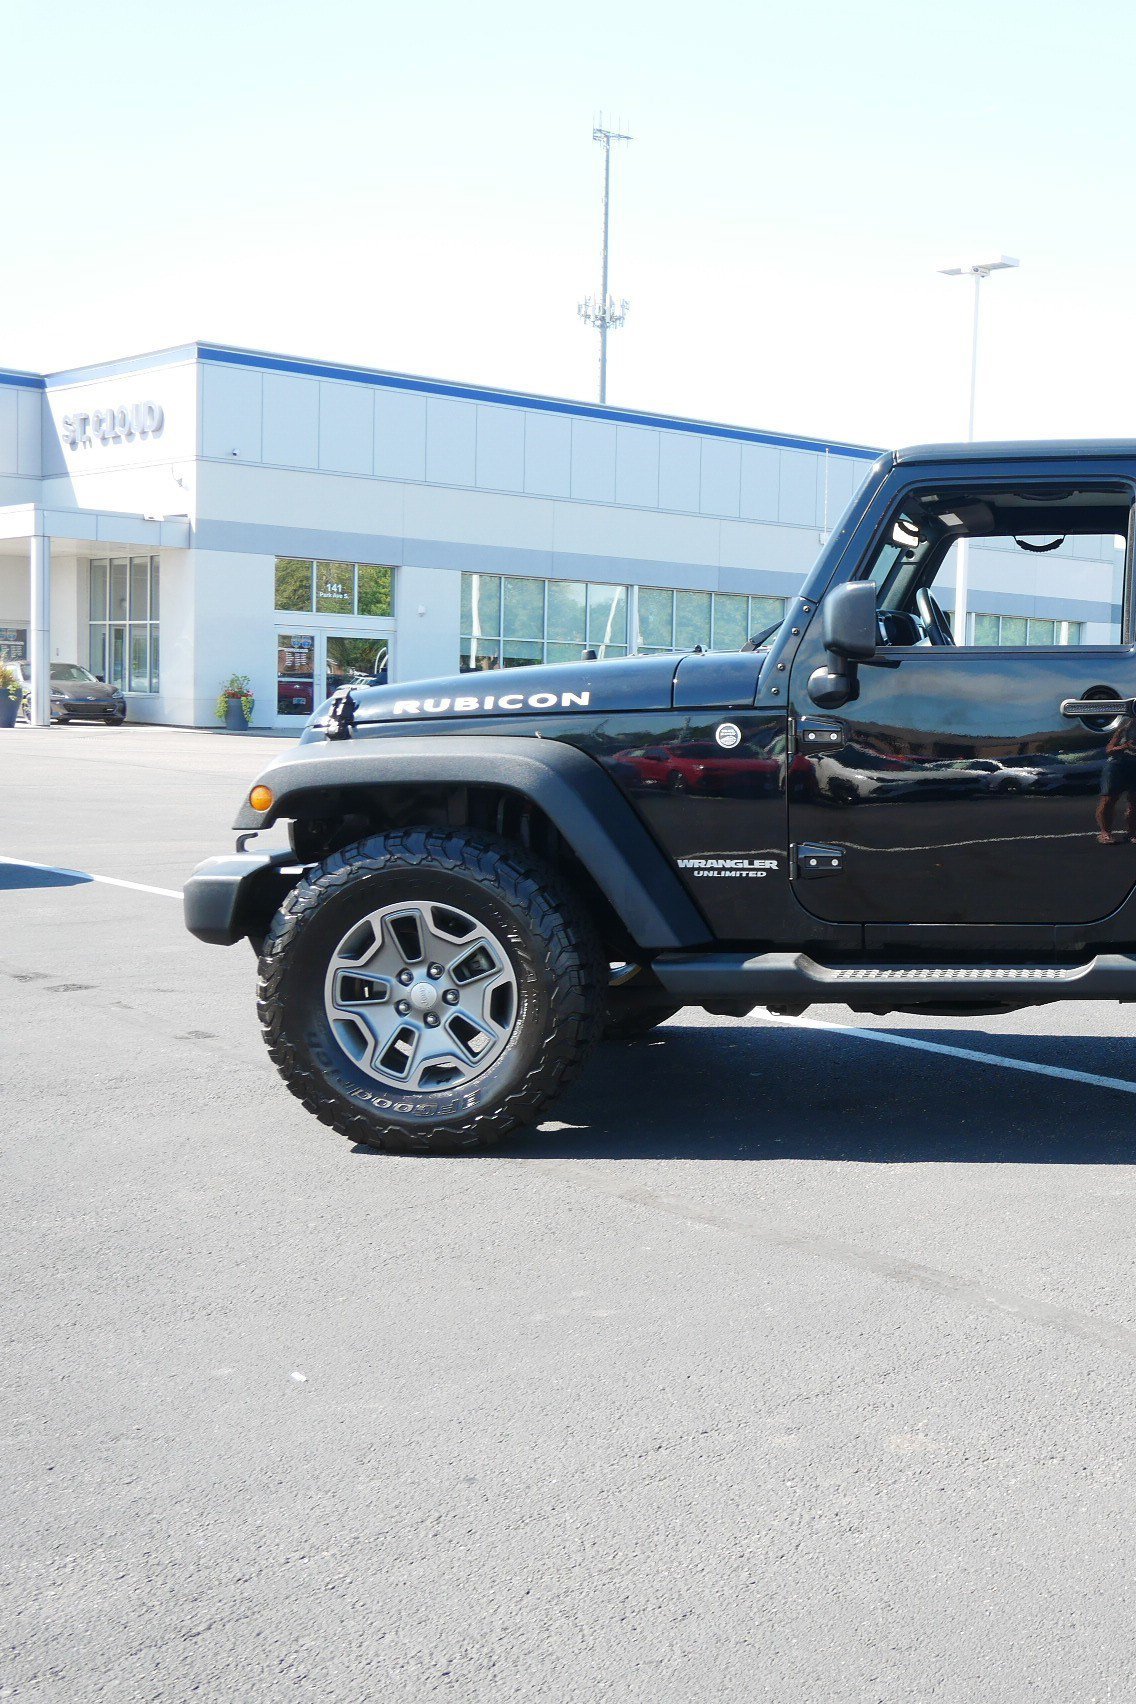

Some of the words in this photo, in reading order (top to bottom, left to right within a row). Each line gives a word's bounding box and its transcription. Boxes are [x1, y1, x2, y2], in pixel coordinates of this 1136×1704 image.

[62, 413, 91, 447] ST.
[92, 401, 163, 442] CLOUD
[326, 583, 342, 592] 141
[393, 692, 590, 714] RUBICON
[677, 860, 779, 869] WRANGLER
